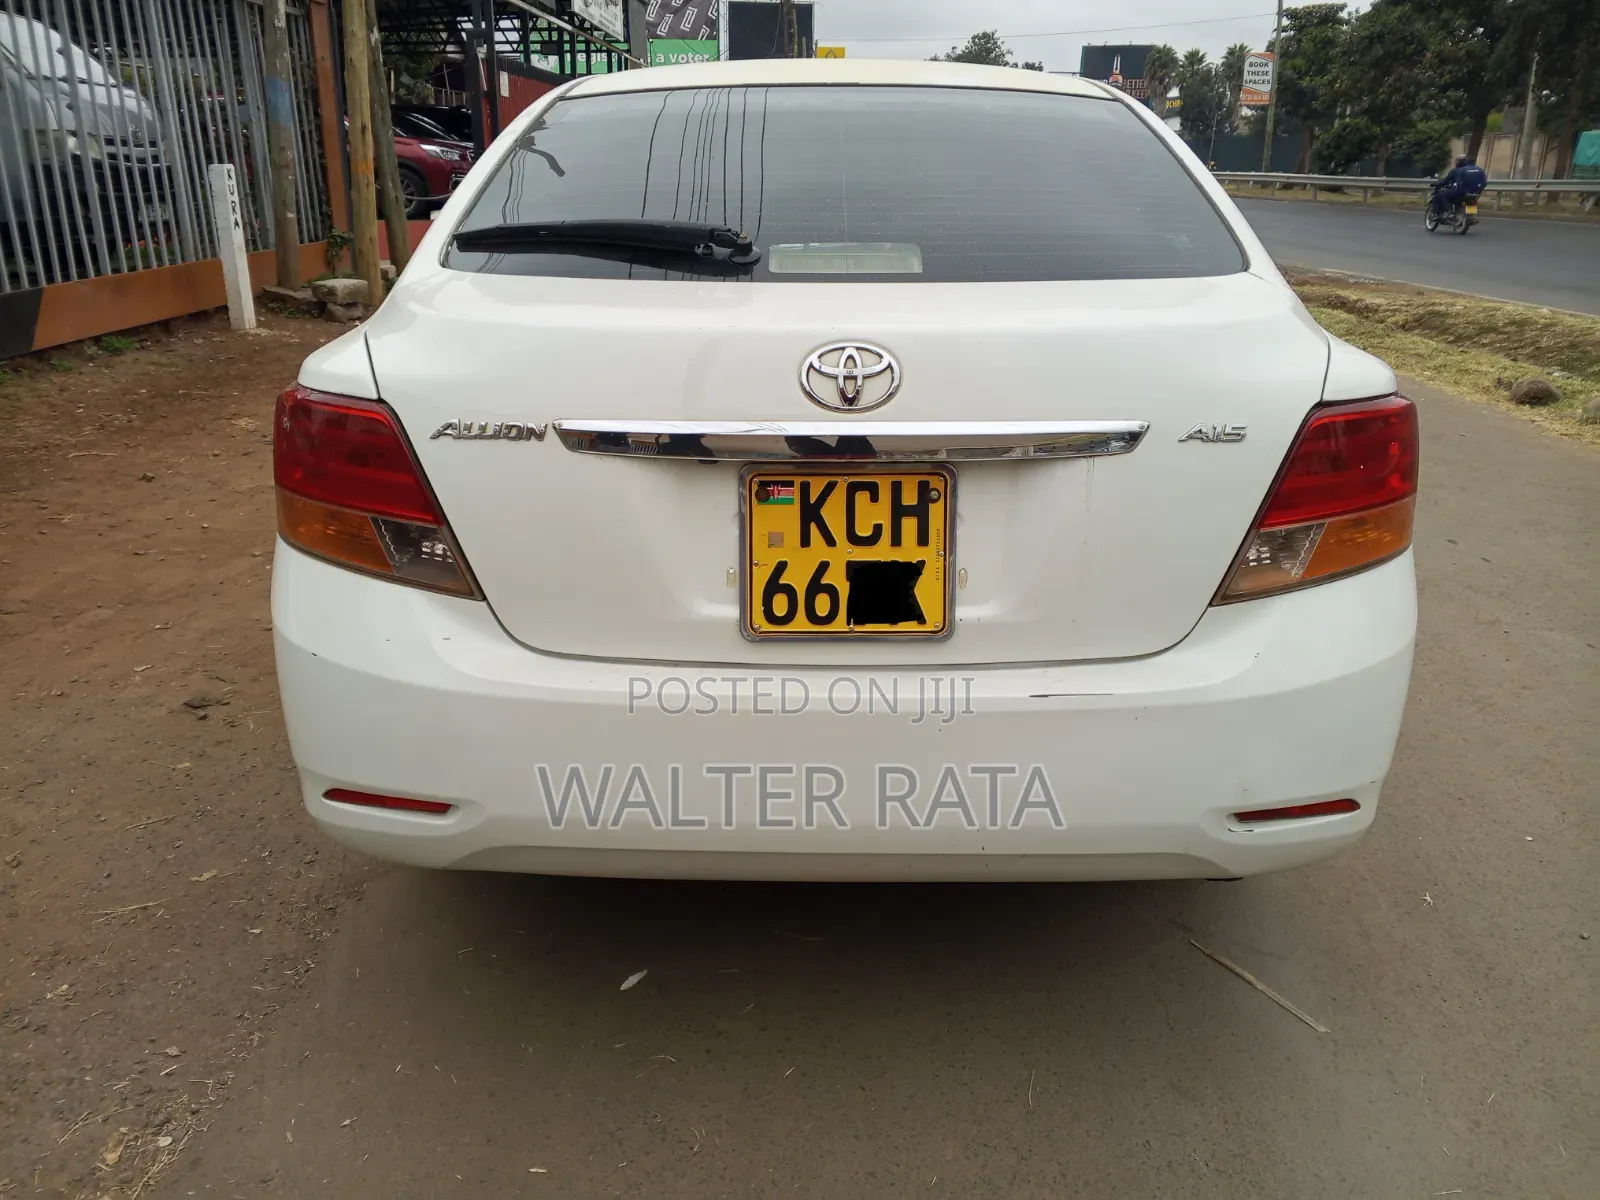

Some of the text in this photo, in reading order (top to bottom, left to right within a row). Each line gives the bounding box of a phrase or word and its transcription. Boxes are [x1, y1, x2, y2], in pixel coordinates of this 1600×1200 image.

[656, 53, 665, 63] a
[668, 51, 710, 64] voter
[226, 168, 241, 231] KURA
[429, 416, 549, 442] ALLION
[1178, 422, 1248, 443] A15
[800, 480, 930, 549] KCH
